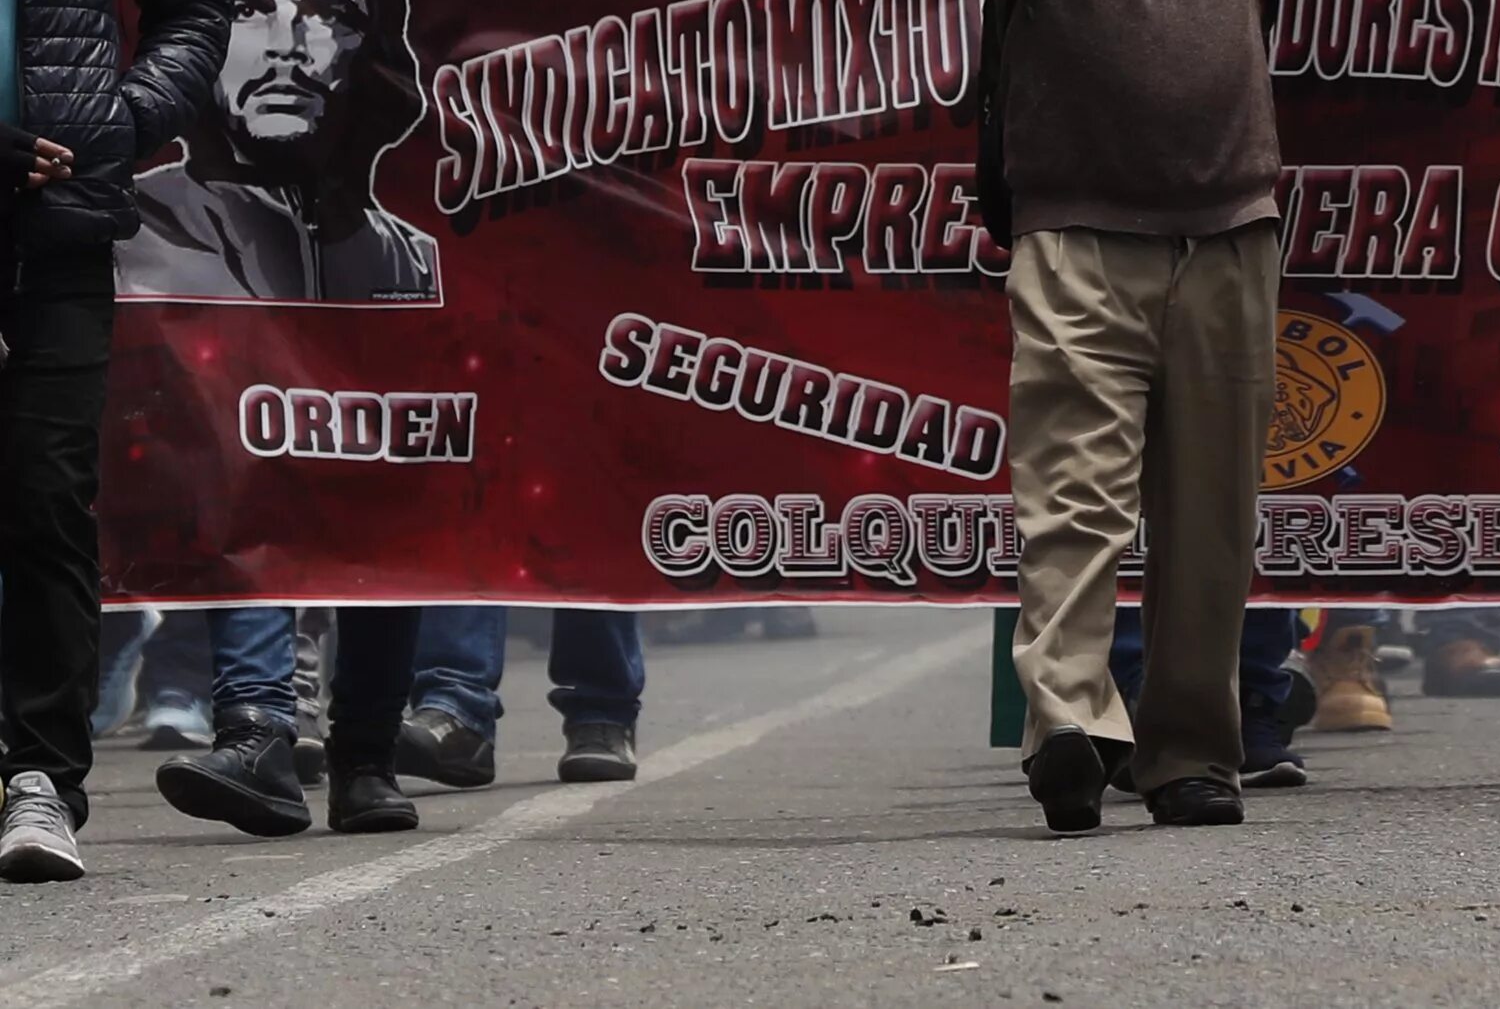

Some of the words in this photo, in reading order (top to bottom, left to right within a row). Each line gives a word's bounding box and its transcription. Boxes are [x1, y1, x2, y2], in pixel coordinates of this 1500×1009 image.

[1281, 319, 1365, 382] BOL
[238, 385, 478, 462] ORDEN
[600, 312, 1006, 481] SEGURIDAD
[1261, 440, 1347, 483] VIA
